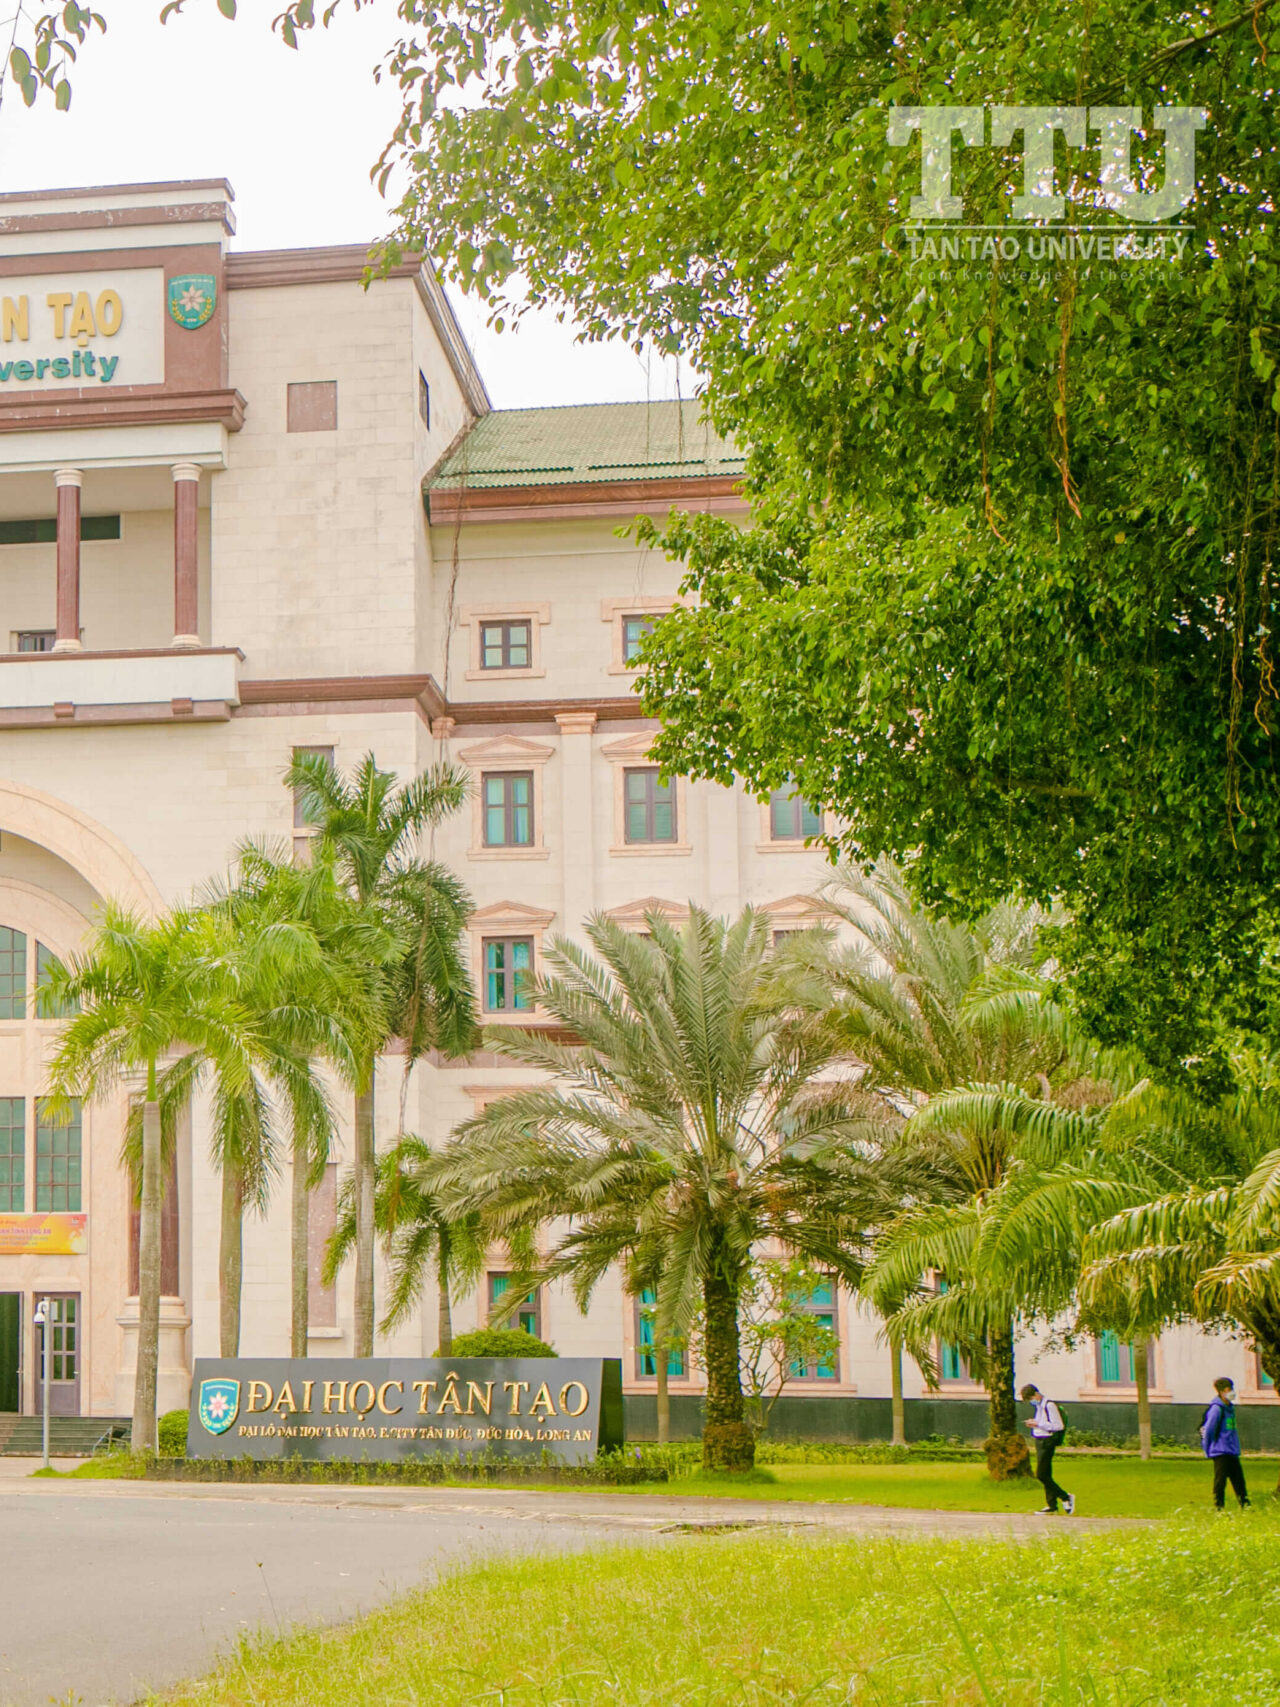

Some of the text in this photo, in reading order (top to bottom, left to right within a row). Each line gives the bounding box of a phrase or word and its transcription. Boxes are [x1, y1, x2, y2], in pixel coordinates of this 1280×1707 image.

[47, 288, 123, 346] TẠO
[246, 1370, 589, 1423] ĐẠI HỌC TÂN TẠO
[419, 1426, 443, 1439] TÂN
[536, 1429, 570, 1441] LONG
[573, 1429, 592, 1441] AN
